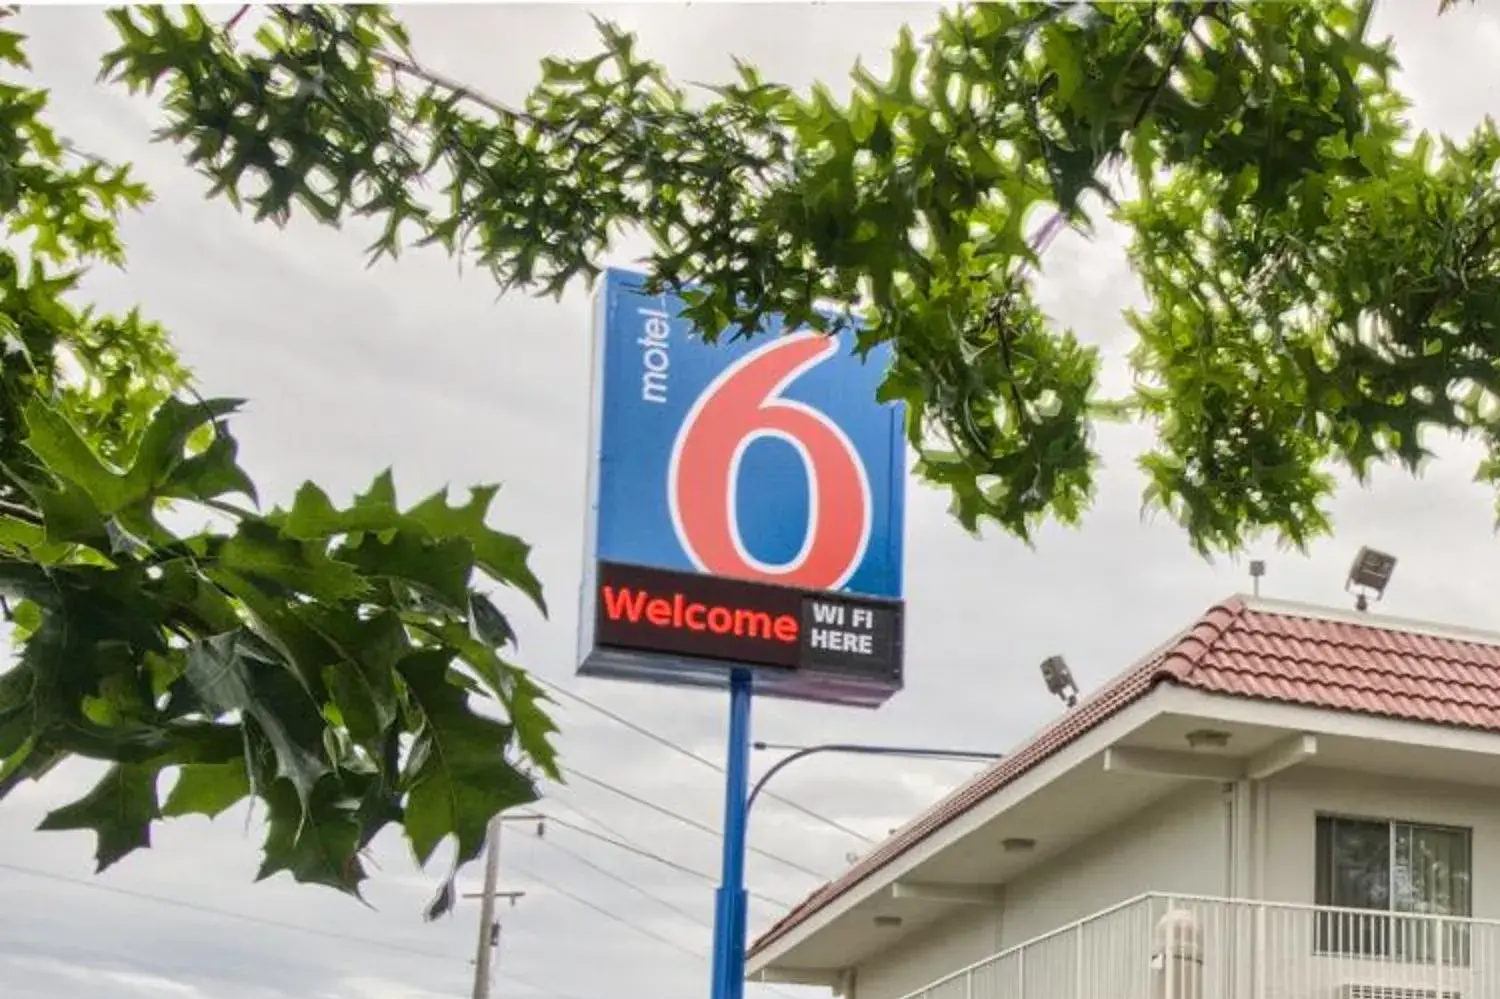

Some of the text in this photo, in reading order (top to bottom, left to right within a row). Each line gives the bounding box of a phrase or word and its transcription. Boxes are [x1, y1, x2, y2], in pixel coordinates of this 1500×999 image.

[637, 306, 669, 403] motel
[668, 329, 872, 592] 6
[602, 584, 799, 641] Welcome
[812, 602, 873, 629] WI FI
[811, 629, 873, 654] HERE
